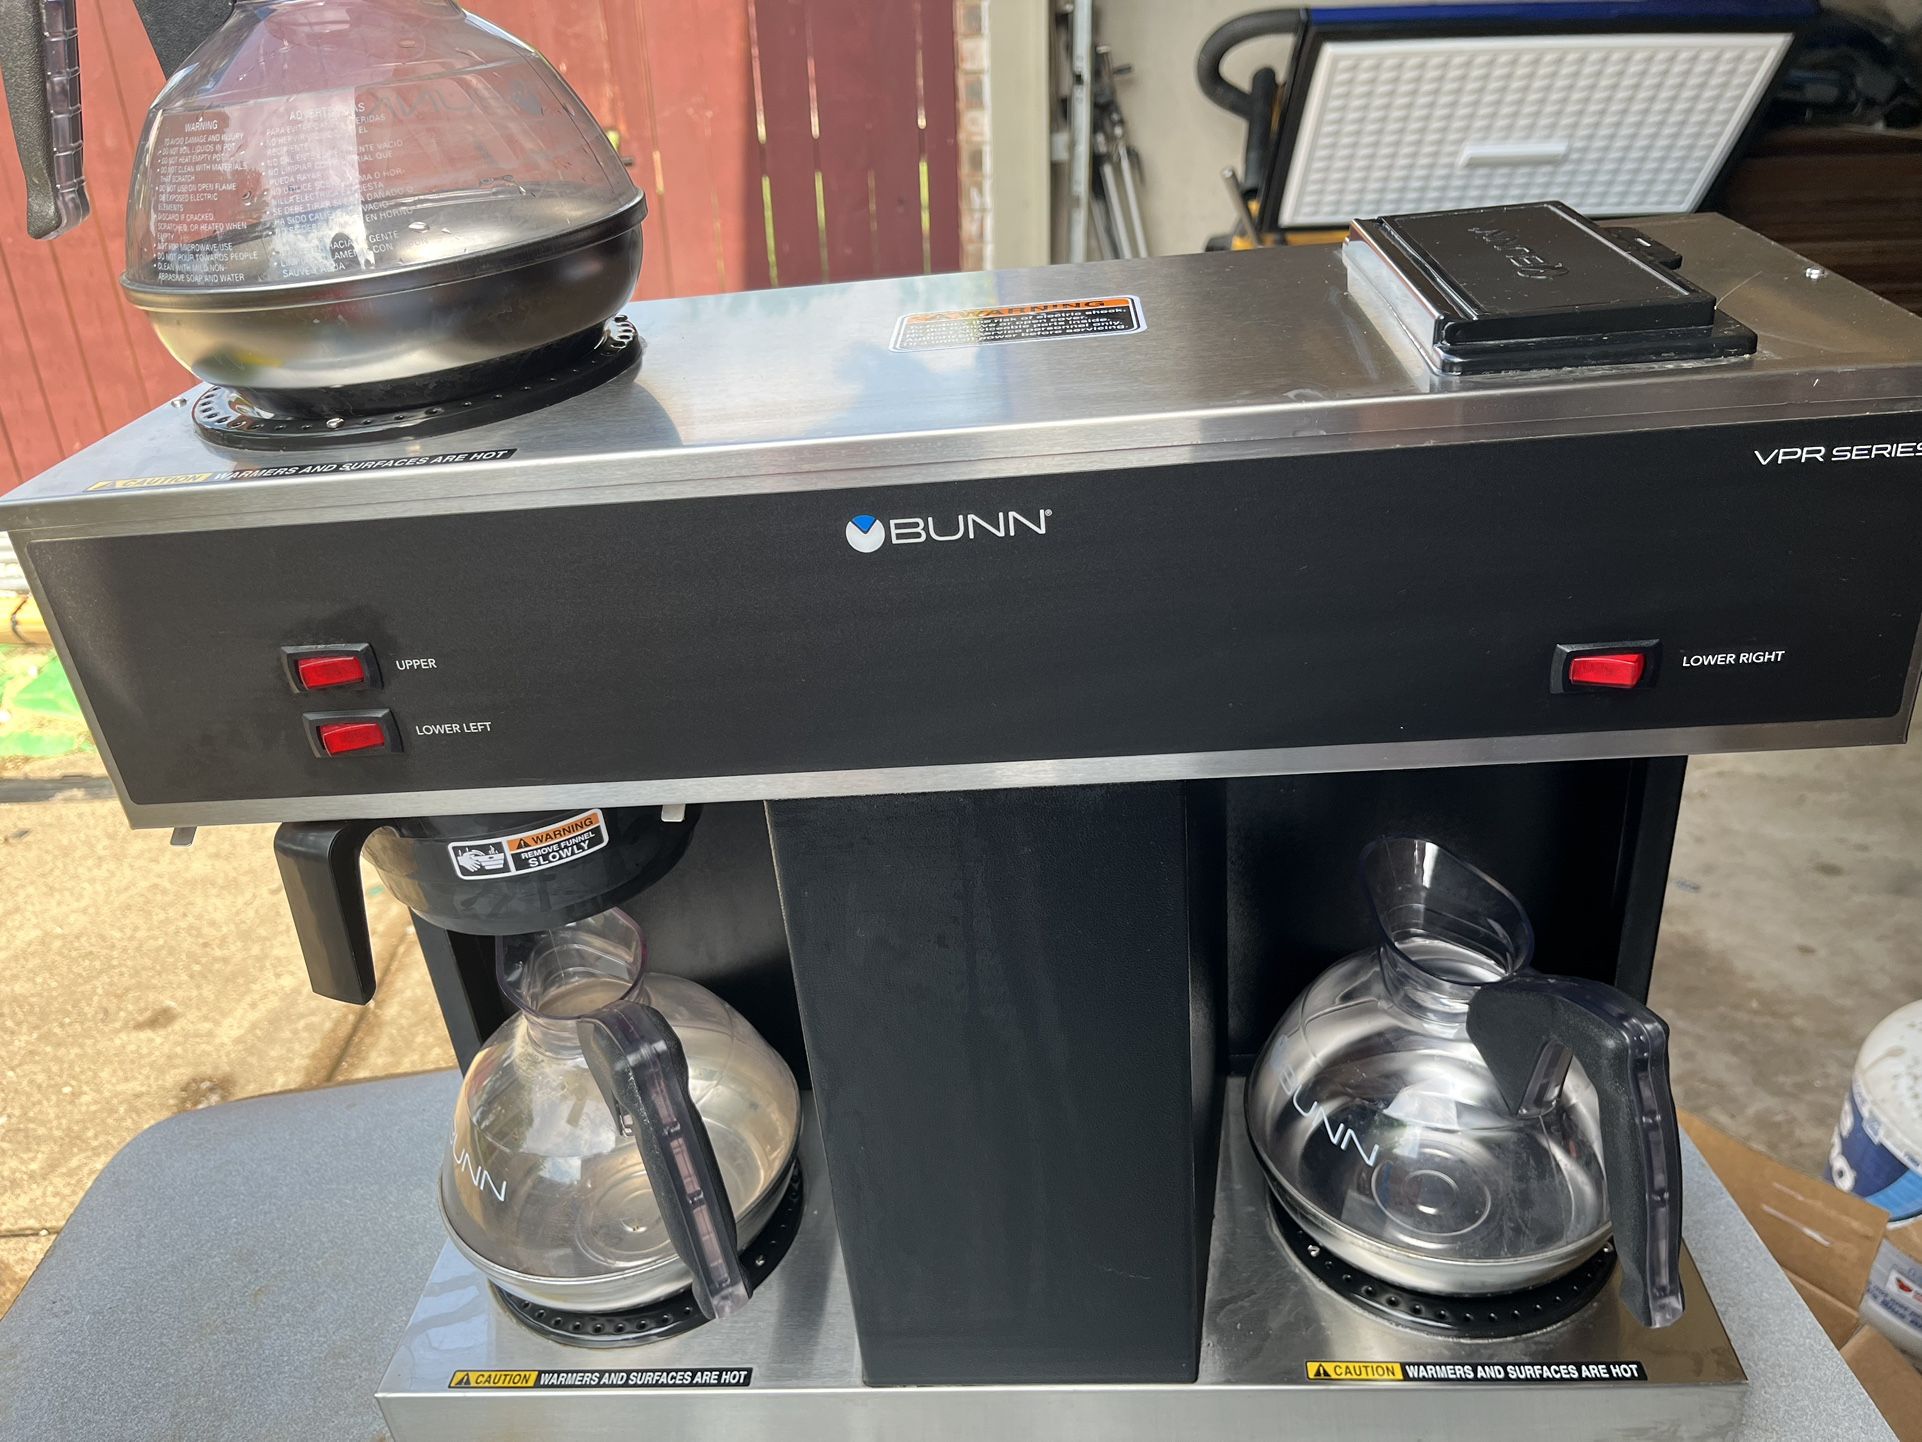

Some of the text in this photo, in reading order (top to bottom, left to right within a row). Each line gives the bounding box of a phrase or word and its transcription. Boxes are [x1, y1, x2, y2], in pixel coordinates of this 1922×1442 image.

[185, 120, 218, 132] WARNING
[185, 135, 207, 144] DAMAGE
[208, 134, 220, 142] AND
[376, 139, 403, 150] VACIO
[192, 144, 214, 153] LIQUIDS
[180, 155, 191, 164] HEAT
[192, 154, 211, 162] EMPTY
[375, 151, 392, 160] QUE
[178, 165, 195, 173] CLEAN
[211, 161, 247, 171] MATERIALS
[177, 184, 188, 192] USE
[188, 184, 196, 192] ON
[198, 183, 214, 191] OPEN
[215, 183, 237, 191] FLAME
[190, 193, 218, 201] ELECTRIC
[286, 213, 307, 225] SIDO
[365, 213, 377, 222] EN
[190, 223, 198, 231] OR
[200, 223, 224, 231] HEATED
[225, 221, 247, 230] WHEN
[369, 231, 399, 243] GENTE
[180, 243, 218, 252] MICROWAVE
[220, 242, 233, 251] USE
[373, 243, 393, 254] CON
[157, 252, 165, 260] DO
[177, 253, 194, 261] POUR
[195, 252, 229, 262] TOWARDS
[230, 251, 258, 260] PEOPLE
[157, 263, 174, 271] CLEAN
[204, 273, 218, 282] AND
[219, 273, 245, 282] WATER
[958, 301, 1105, 318] WARNING
[1754, 445, 1826, 466] VPR
[121, 450, 509, 487] CAUTION WARMERS AND SURFACES ARE HOT
[395, 658, 437, 671] UPPER
[1682, 650, 1786, 667] LOWER RIGHT
[415, 721, 492, 736] LOWER LEFT
[531, 817, 594, 845] WARNING
[521, 831, 596, 860] REMOVE FUNNEL
[528, 840, 590, 868] SLOWLY
[1333, 1363, 1639, 1379] CAUTION WARMERS AND SURFACES ARE HOT
[475, 1370, 748, 1385] CAUTION WARMERS AND SURFACES ARE HOT
